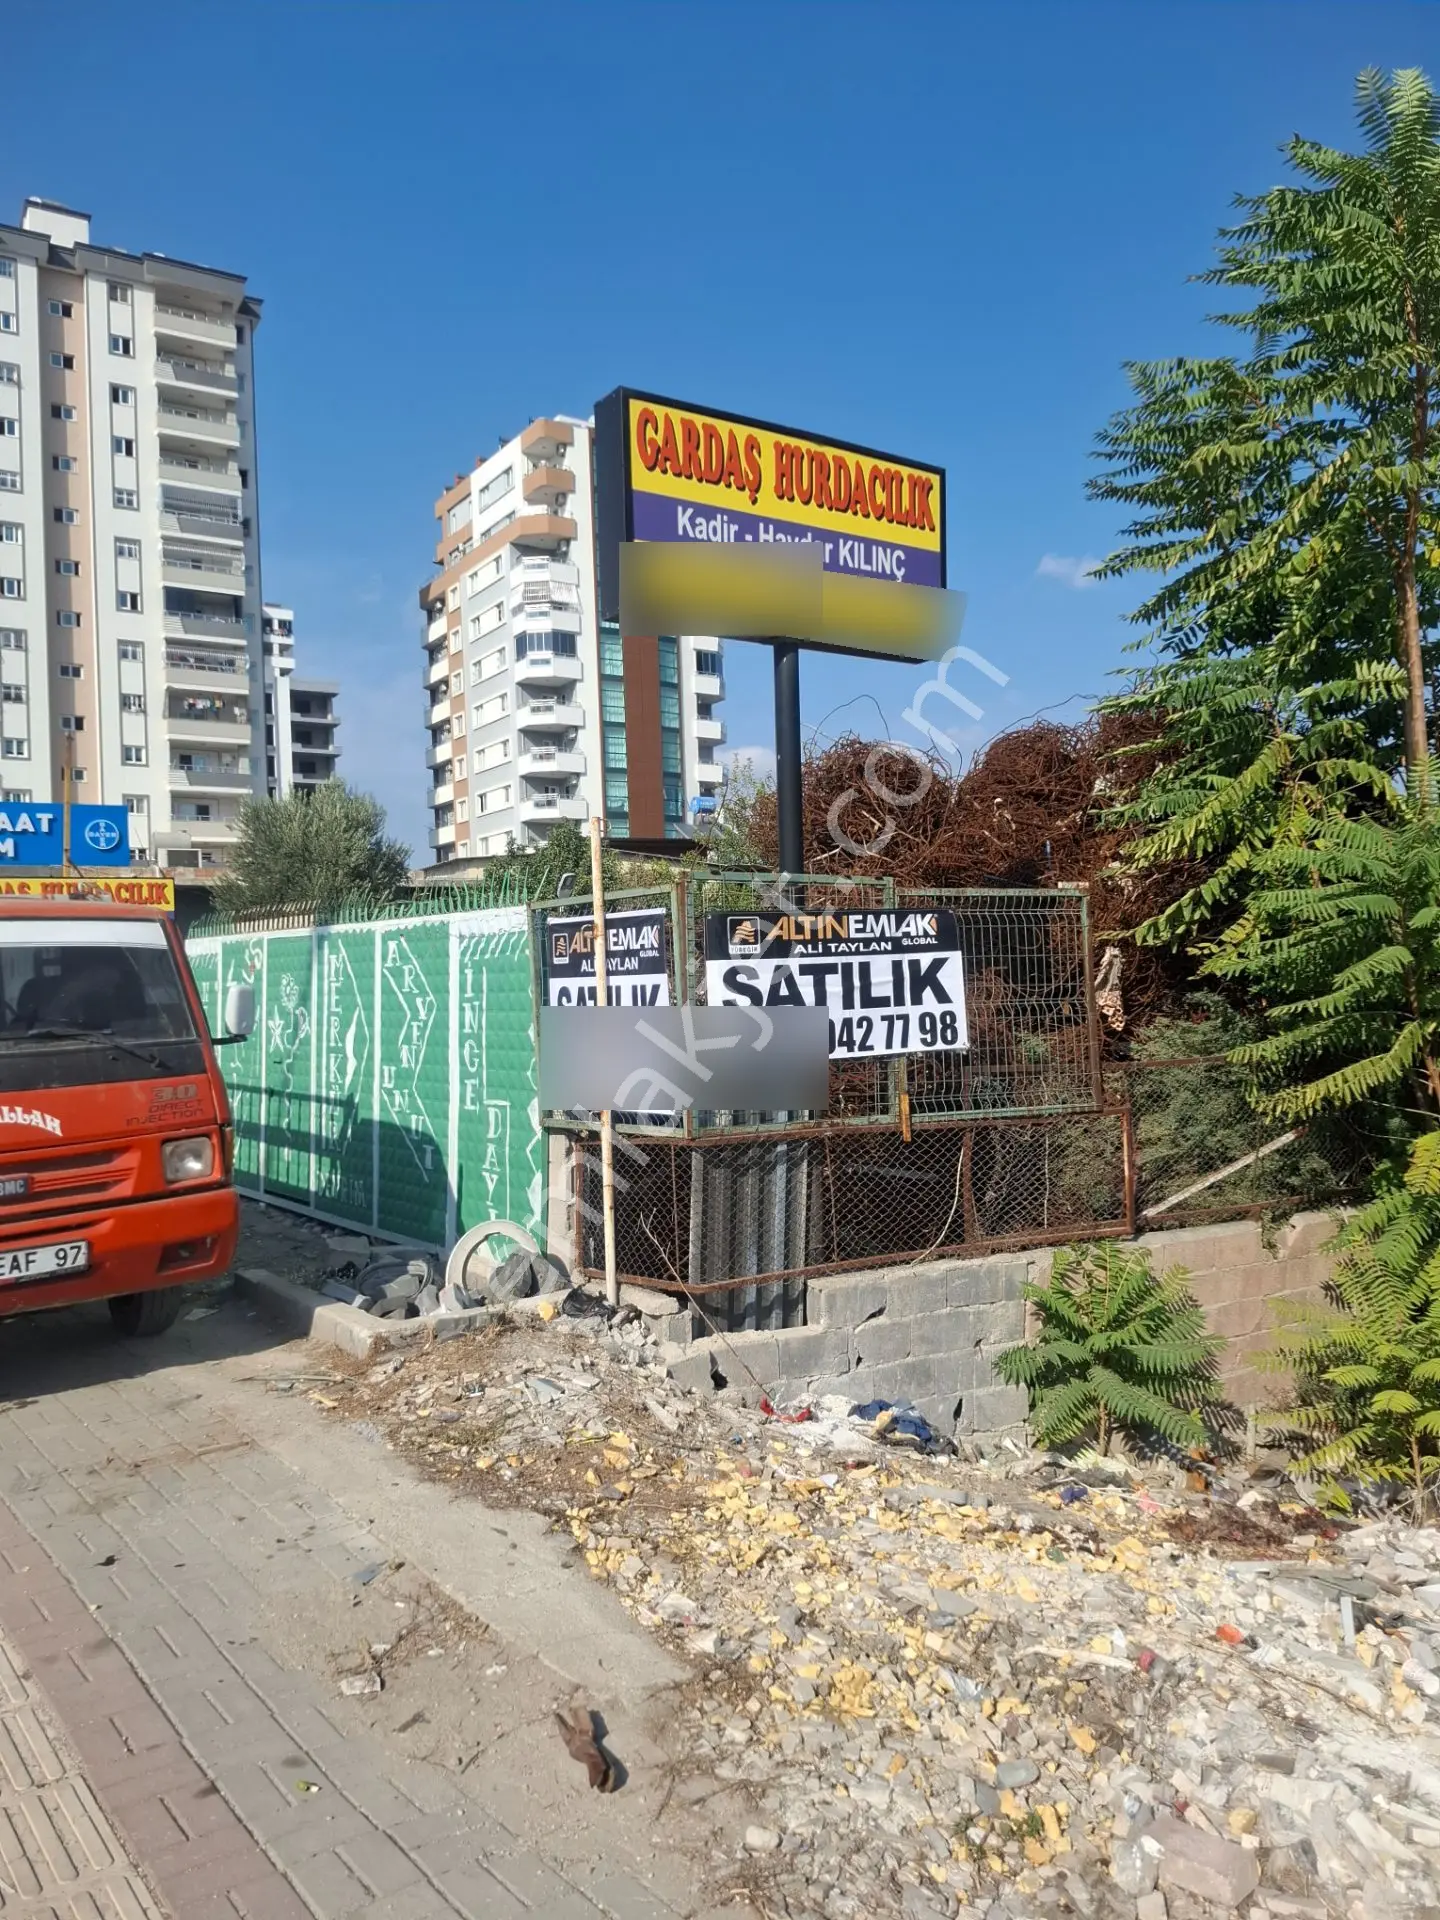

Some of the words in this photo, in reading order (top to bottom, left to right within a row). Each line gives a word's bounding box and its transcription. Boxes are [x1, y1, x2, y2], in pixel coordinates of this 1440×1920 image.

[636, 407, 761, 505] GARDAŞ
[773, 440, 936, 532] HURDACILIK
[677, 505, 738, 542] Kadir
[839, 539, 906, 582] KILINÇ
[40, 881, 170, 905] HUACILIK
[569, 924, 659, 954] ALTEMLAK
[794, 941, 823, 954] ALİ
[827, 941, 893, 953] TAYLAN
[901, 937, 938, 946] GLOBAL
[722, 956, 954, 1010] SATILIK
[880, 1013, 910, 1050] 77
[919, 1010, 957, 1047] 98
[55, 1245, 82, 1267] 97
